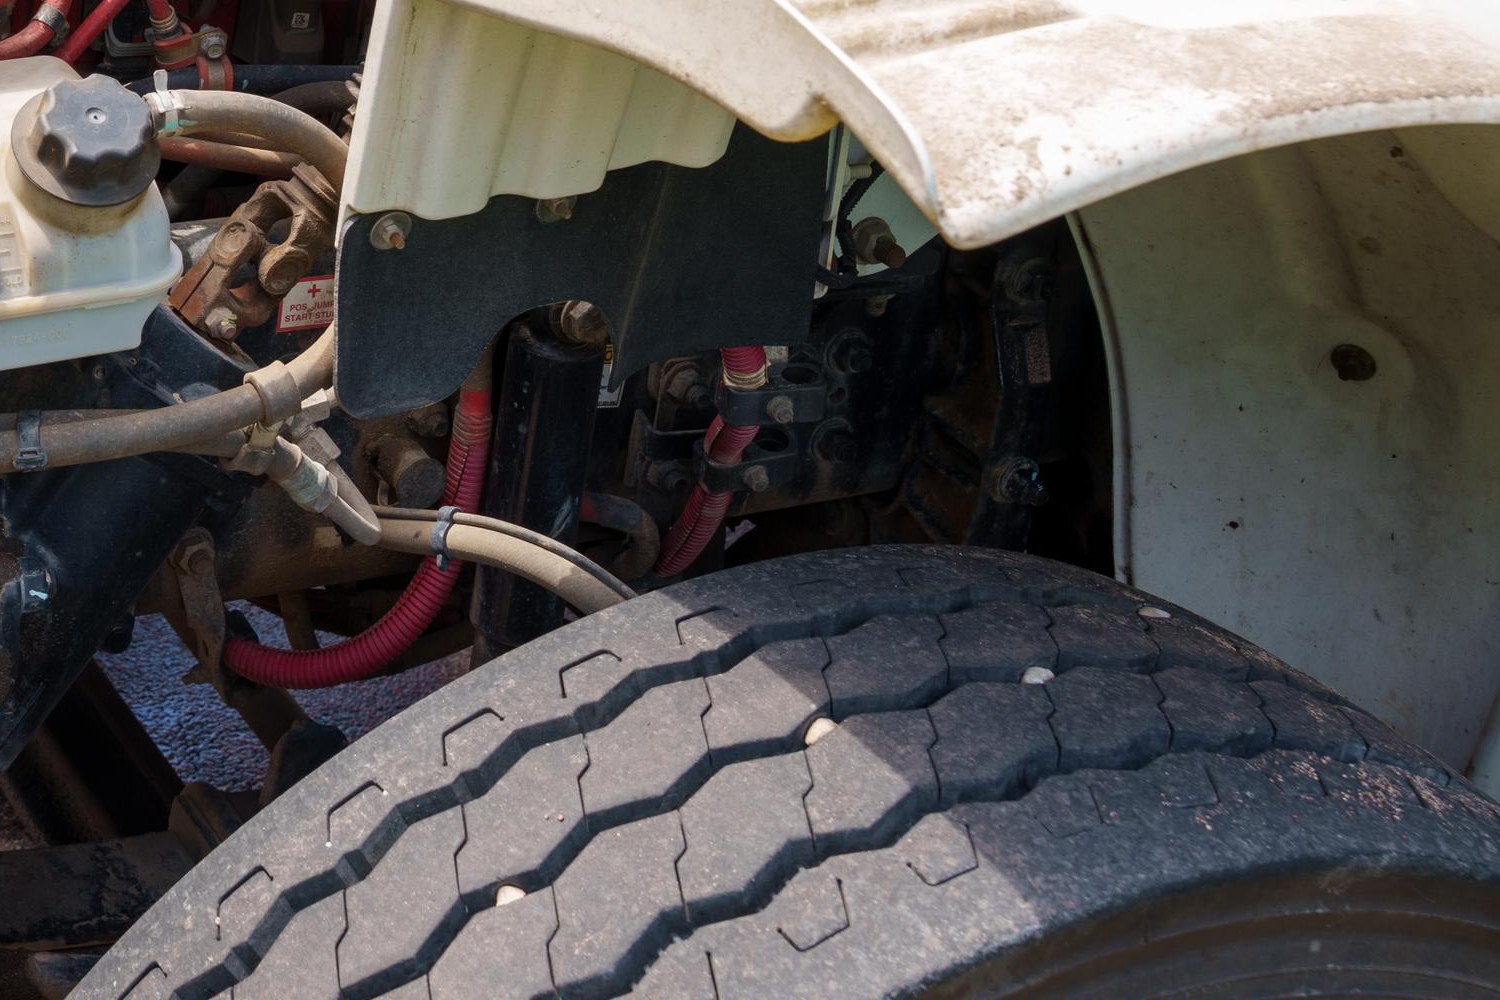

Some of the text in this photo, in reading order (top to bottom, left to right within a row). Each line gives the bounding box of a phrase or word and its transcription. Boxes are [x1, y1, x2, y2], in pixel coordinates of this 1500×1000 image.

[289, 300, 335, 312] POS JUMP
[284, 311, 335, 323] START STU
